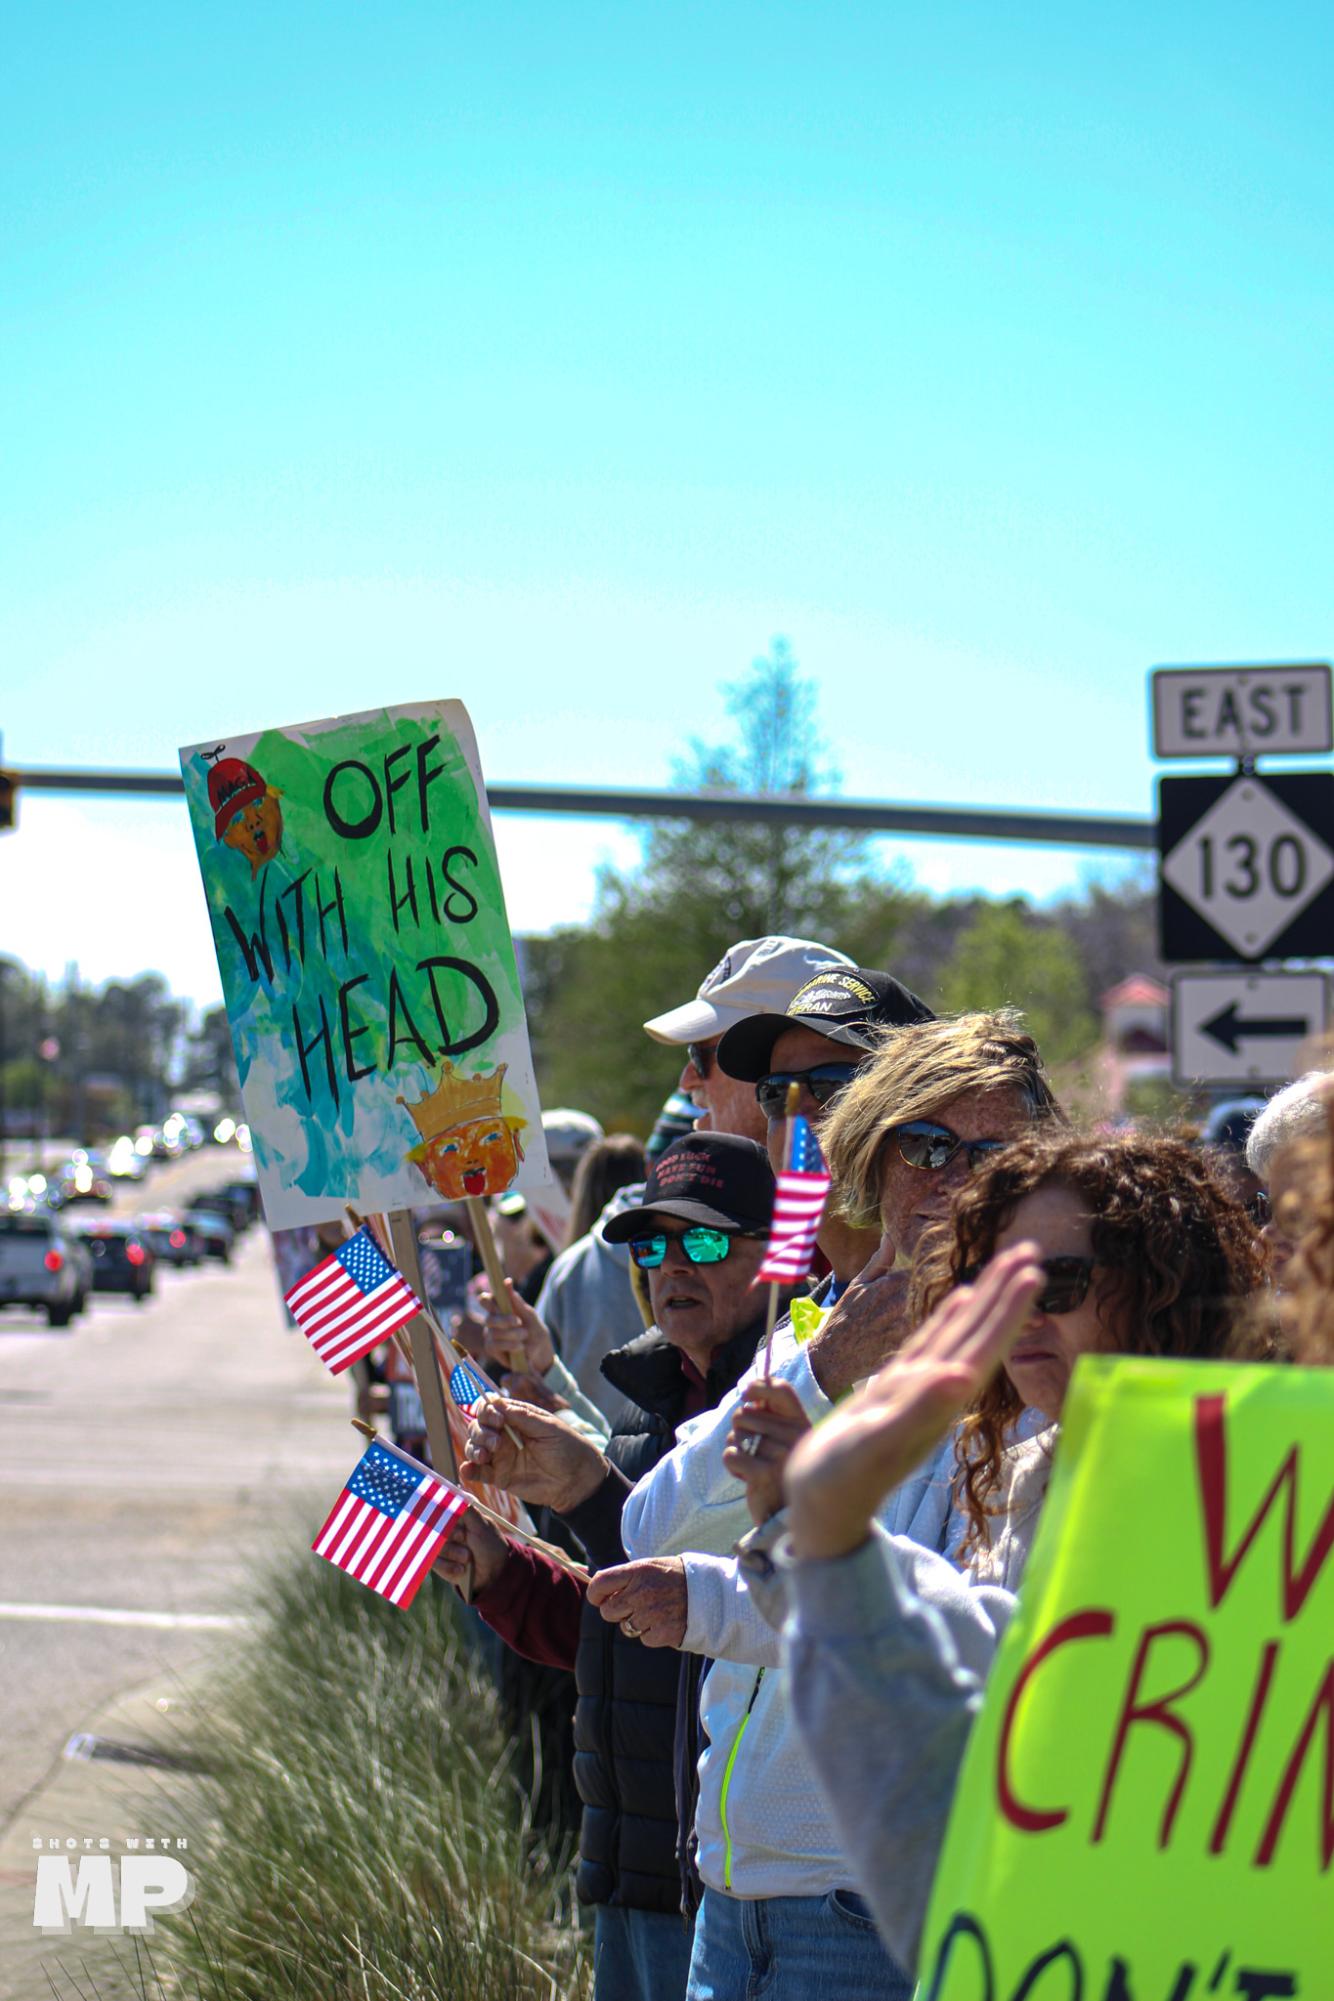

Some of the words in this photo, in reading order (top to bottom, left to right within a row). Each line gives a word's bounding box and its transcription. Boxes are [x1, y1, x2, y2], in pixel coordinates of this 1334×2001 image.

[1180, 683, 1308, 739] EAST
[323, 735, 448, 839] OFF
[1200, 834, 1307, 899] 130
[224, 865, 349, 985] WITH
[387, 845, 478, 934] HIS
[838, 976, 875, 1005] SERVICE
[292, 956, 499, 1112] HEAD
